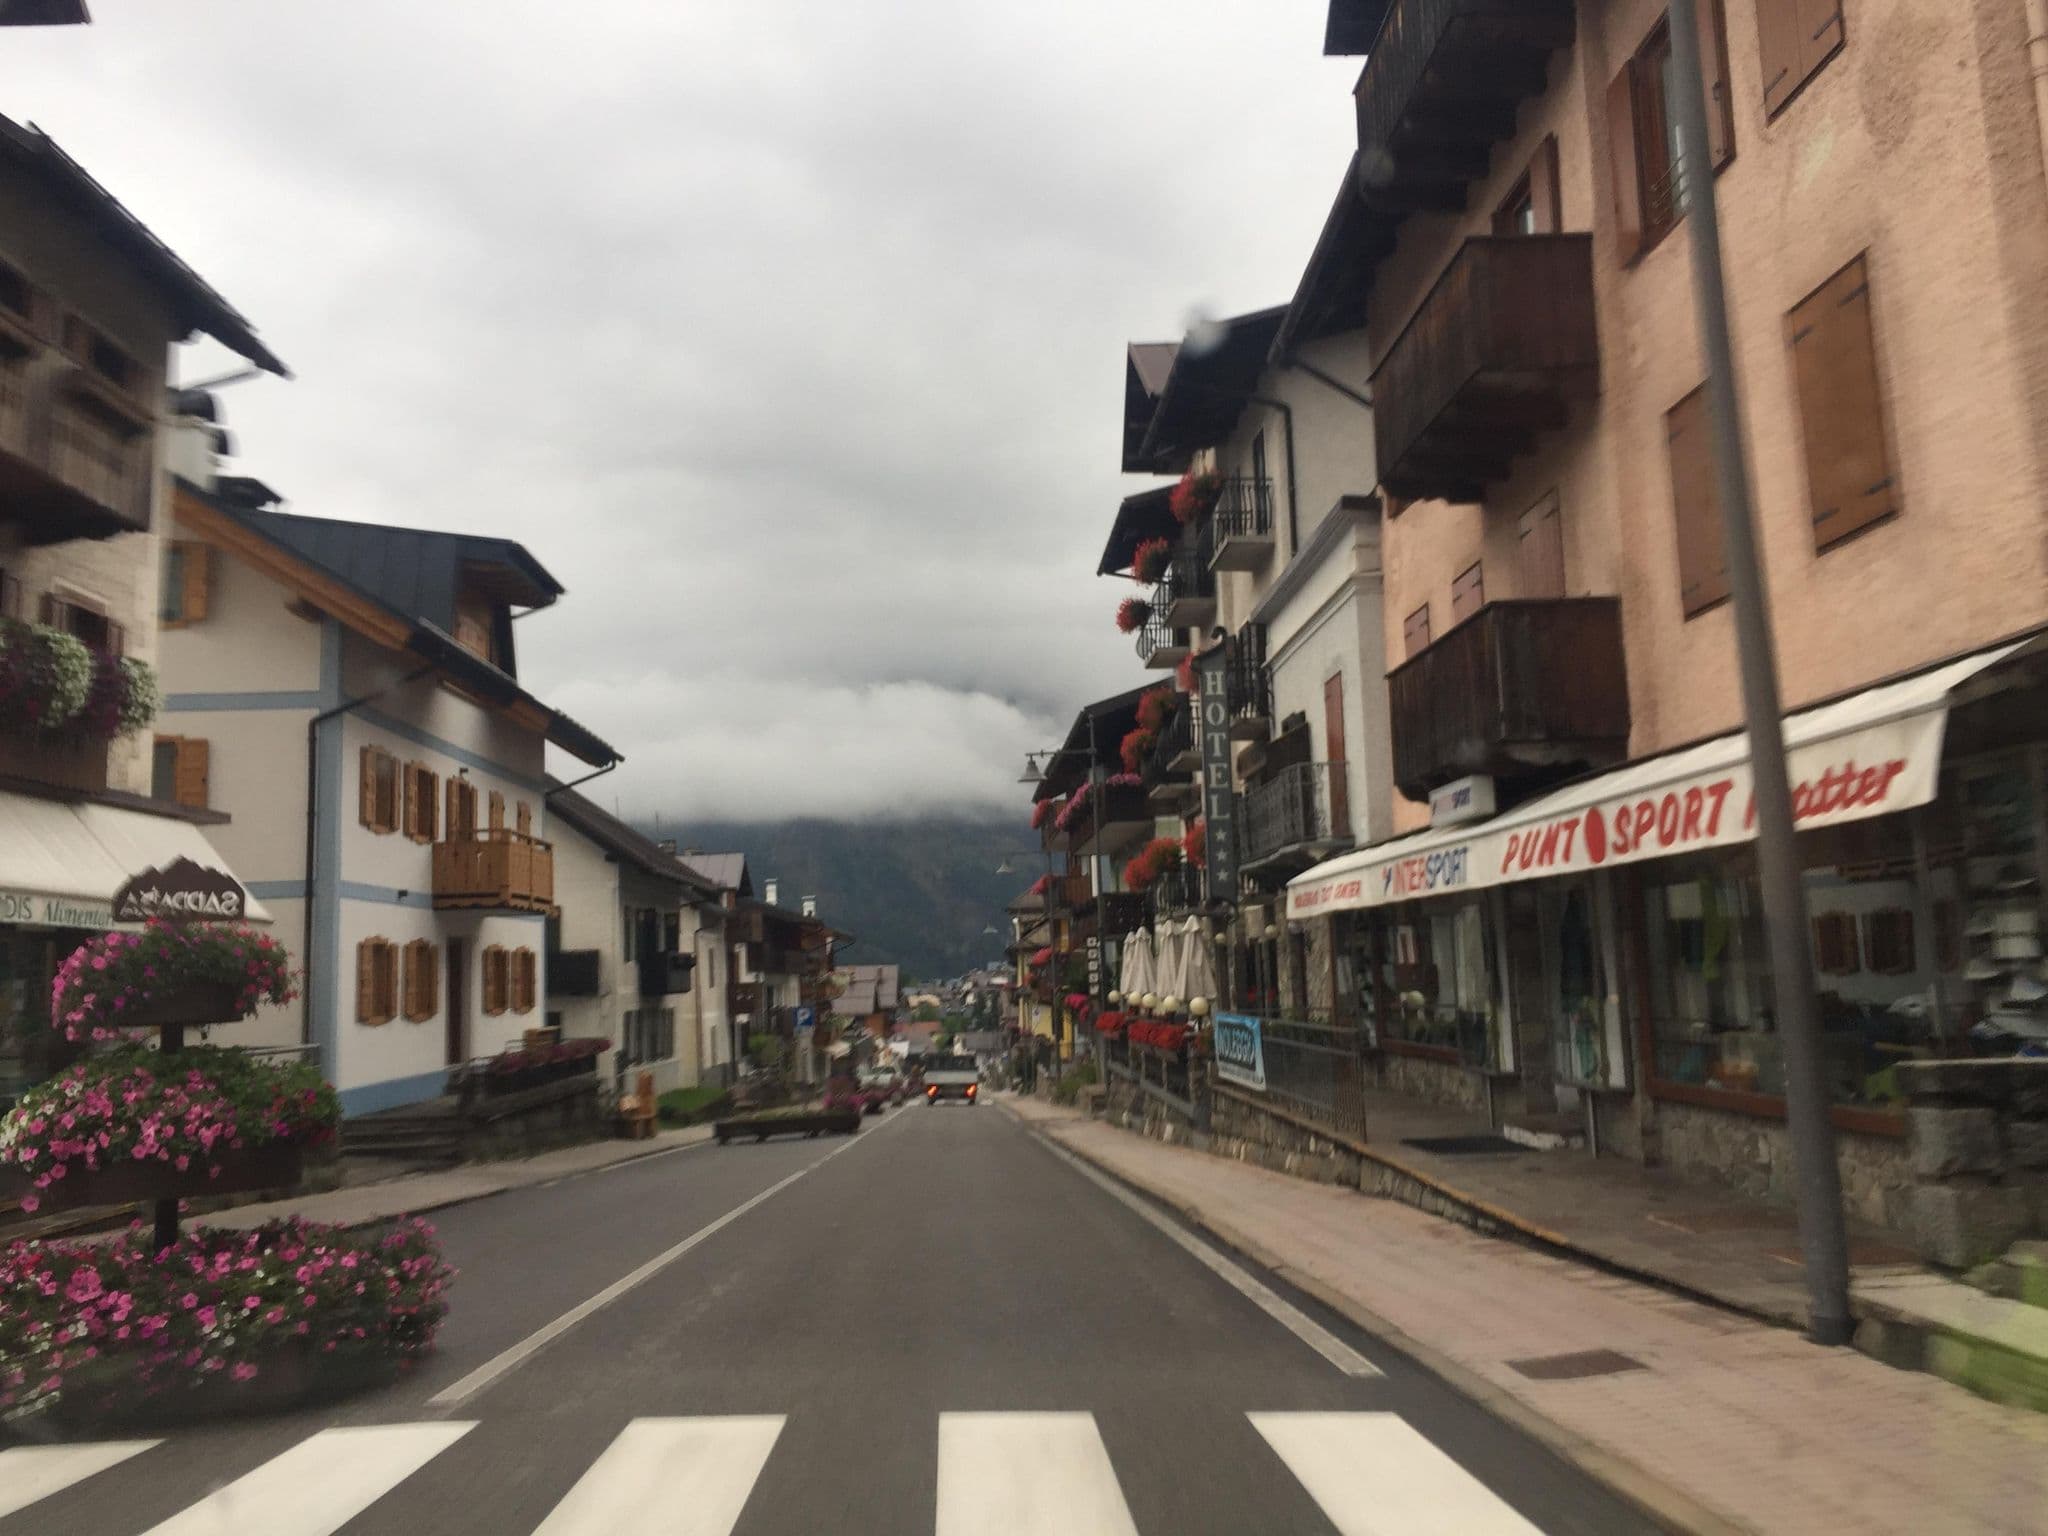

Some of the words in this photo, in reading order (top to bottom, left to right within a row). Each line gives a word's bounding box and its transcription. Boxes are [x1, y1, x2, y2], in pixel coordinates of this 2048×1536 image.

[1205, 671, 1230, 820] HOTEL
[1612, 778, 1734, 855] SPORT
[1392, 847, 1468, 896] INTERSPORT
